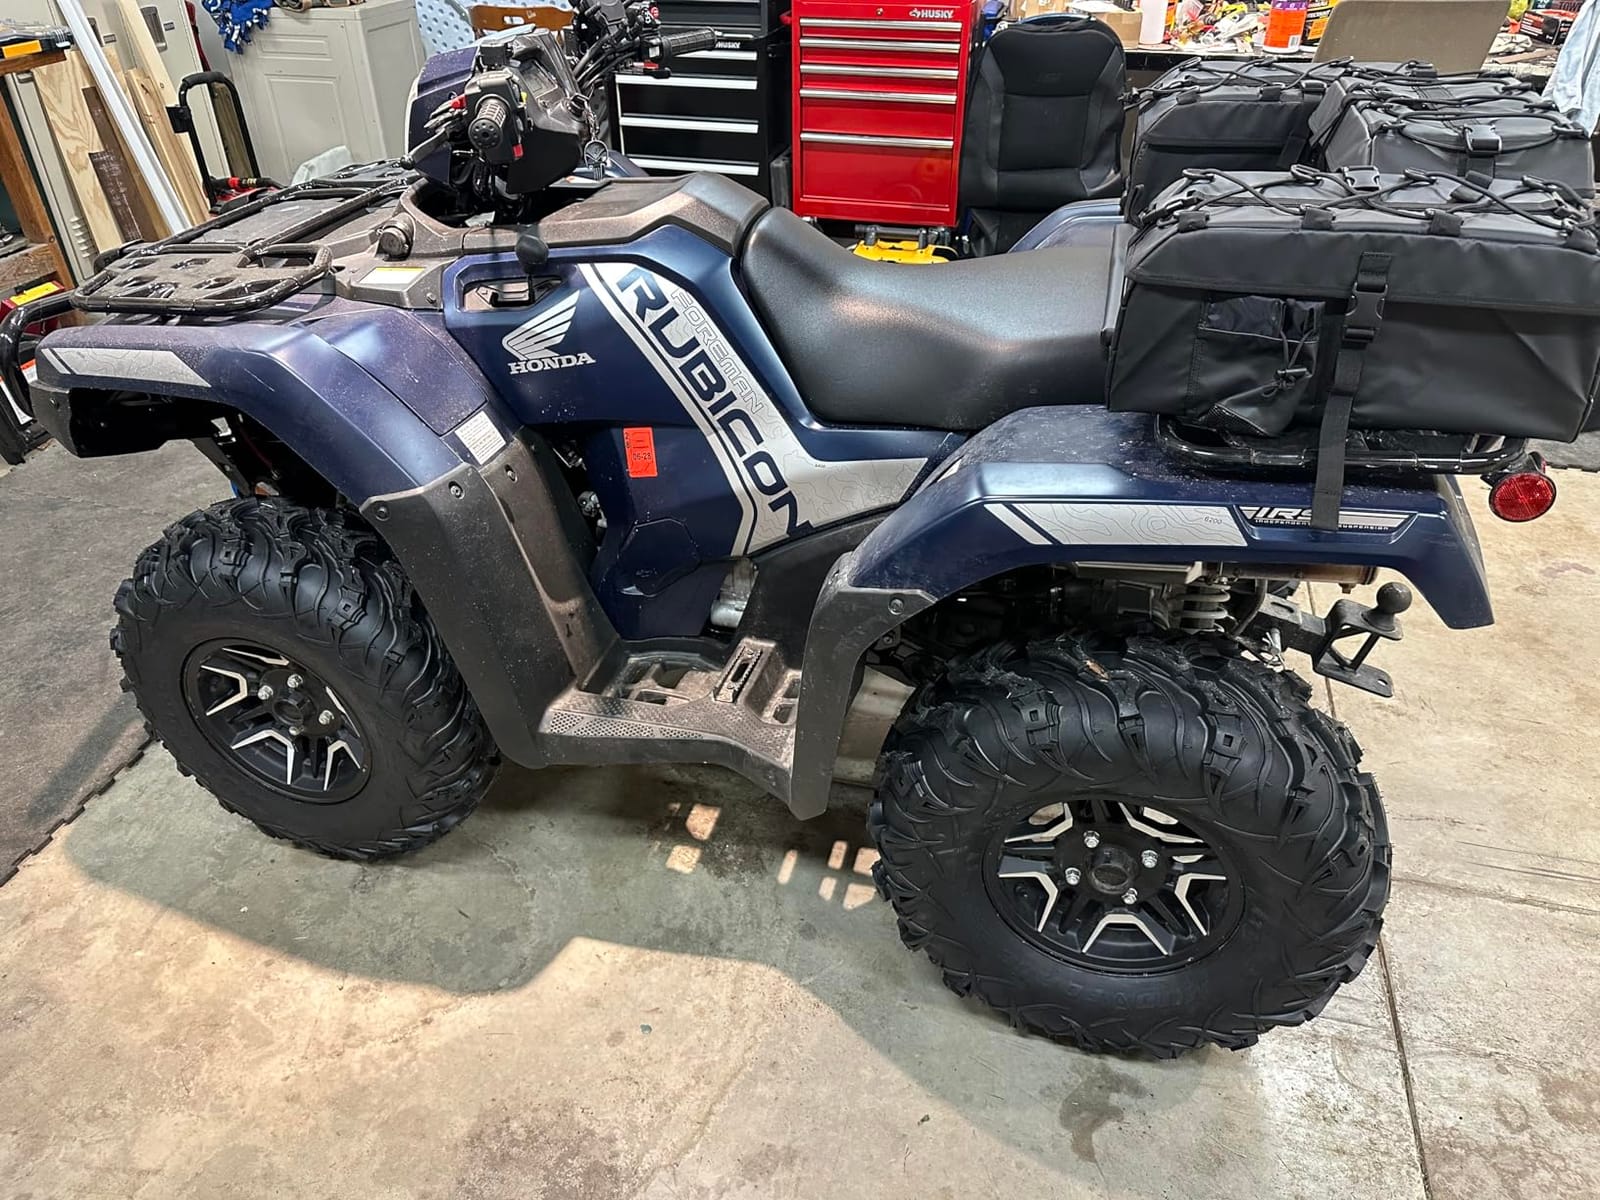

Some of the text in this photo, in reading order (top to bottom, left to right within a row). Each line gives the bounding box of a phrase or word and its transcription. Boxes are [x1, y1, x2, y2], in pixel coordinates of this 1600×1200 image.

[921, 9, 954, 19] HUSKY
[508, 352, 596, 375] HONDA
[671, 288, 764, 414] FOREMAN
[616, 267, 813, 537] RUBICON
